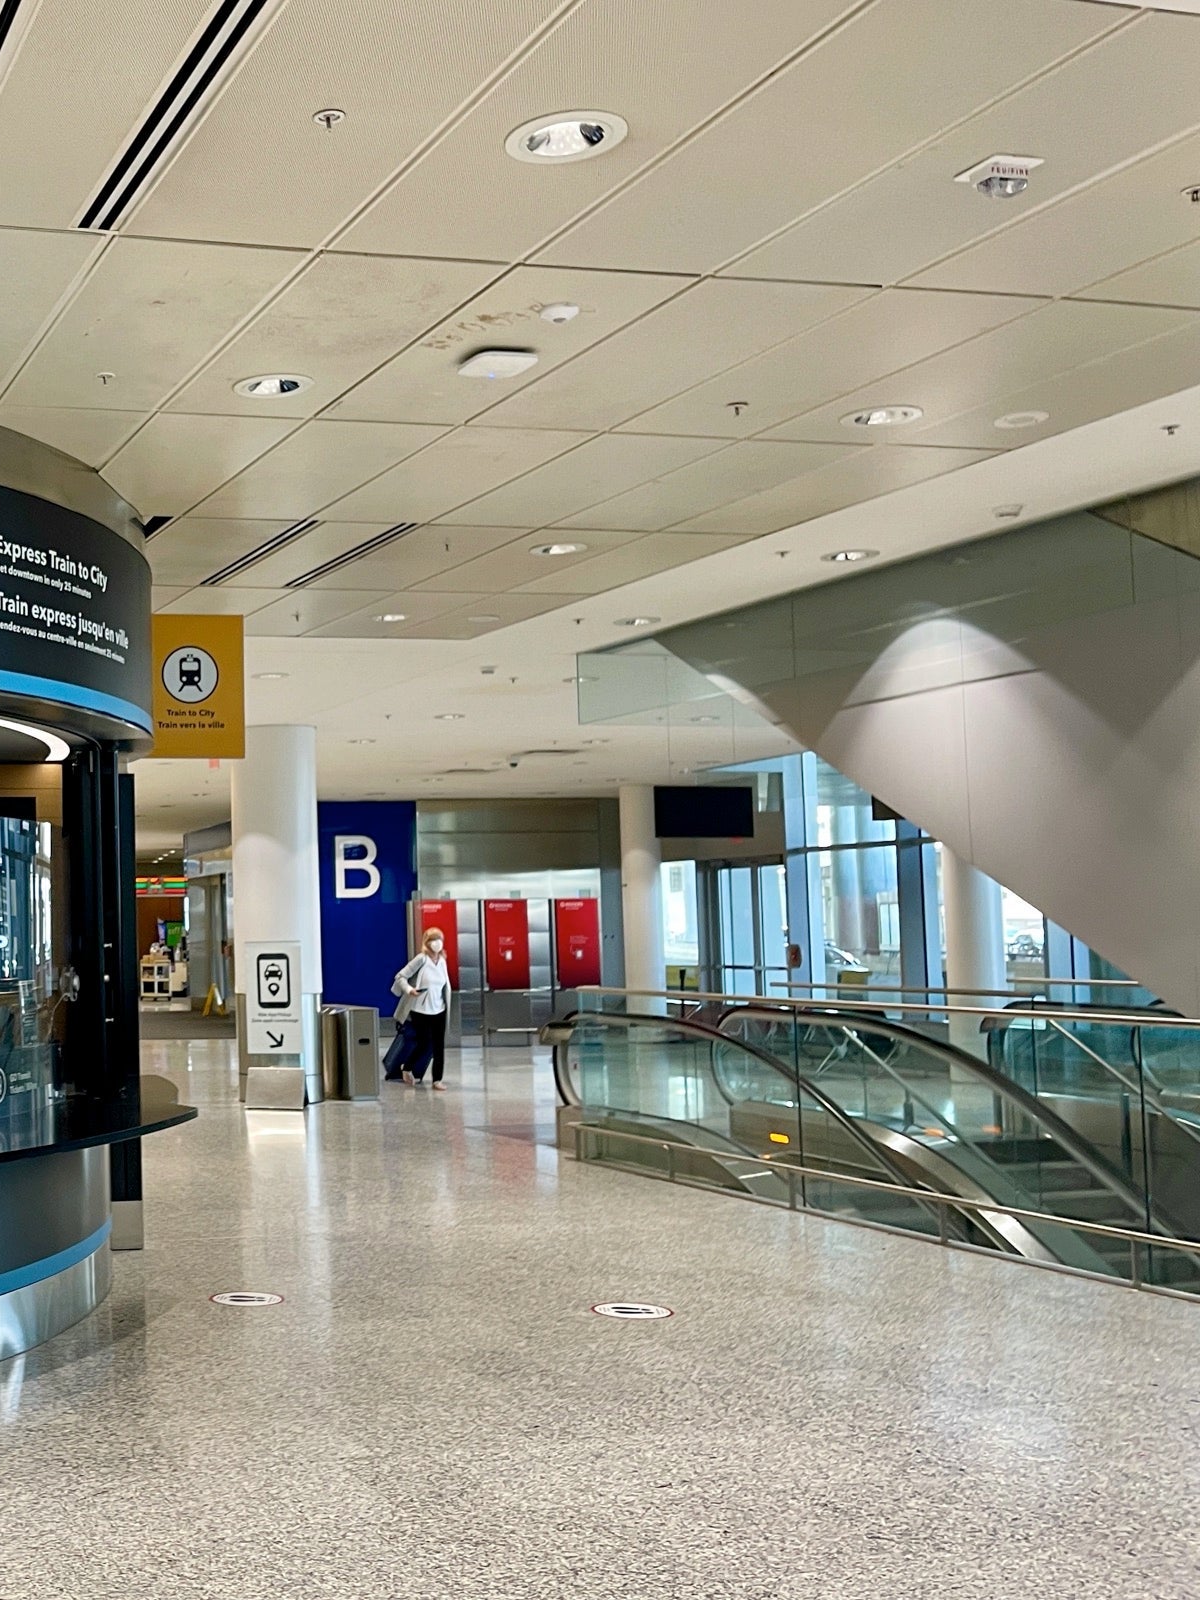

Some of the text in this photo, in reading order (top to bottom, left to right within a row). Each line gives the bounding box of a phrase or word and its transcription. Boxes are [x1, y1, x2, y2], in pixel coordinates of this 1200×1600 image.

[8, 565, 44, 583] downtown
[44, 574, 50, 586] in
[50, 578, 64, 592] only
[64, 581, 72, 592] 25
[48, 549, 77, 576] Train
[78, 562, 89, 580] to
[91, 564, 108, 593] City
[31, 604, 77, 629] express
[77, 612, 115, 643] jusqu'en
[115, 628, 129, 650] ville
[38, 630, 46, 639] au
[158, 721, 178, 729] Train
[198, 721, 206, 729] la
[208, 721, 225, 729] ville
[166, 709, 216, 719] Train to City
[335, 834, 381, 899] B
